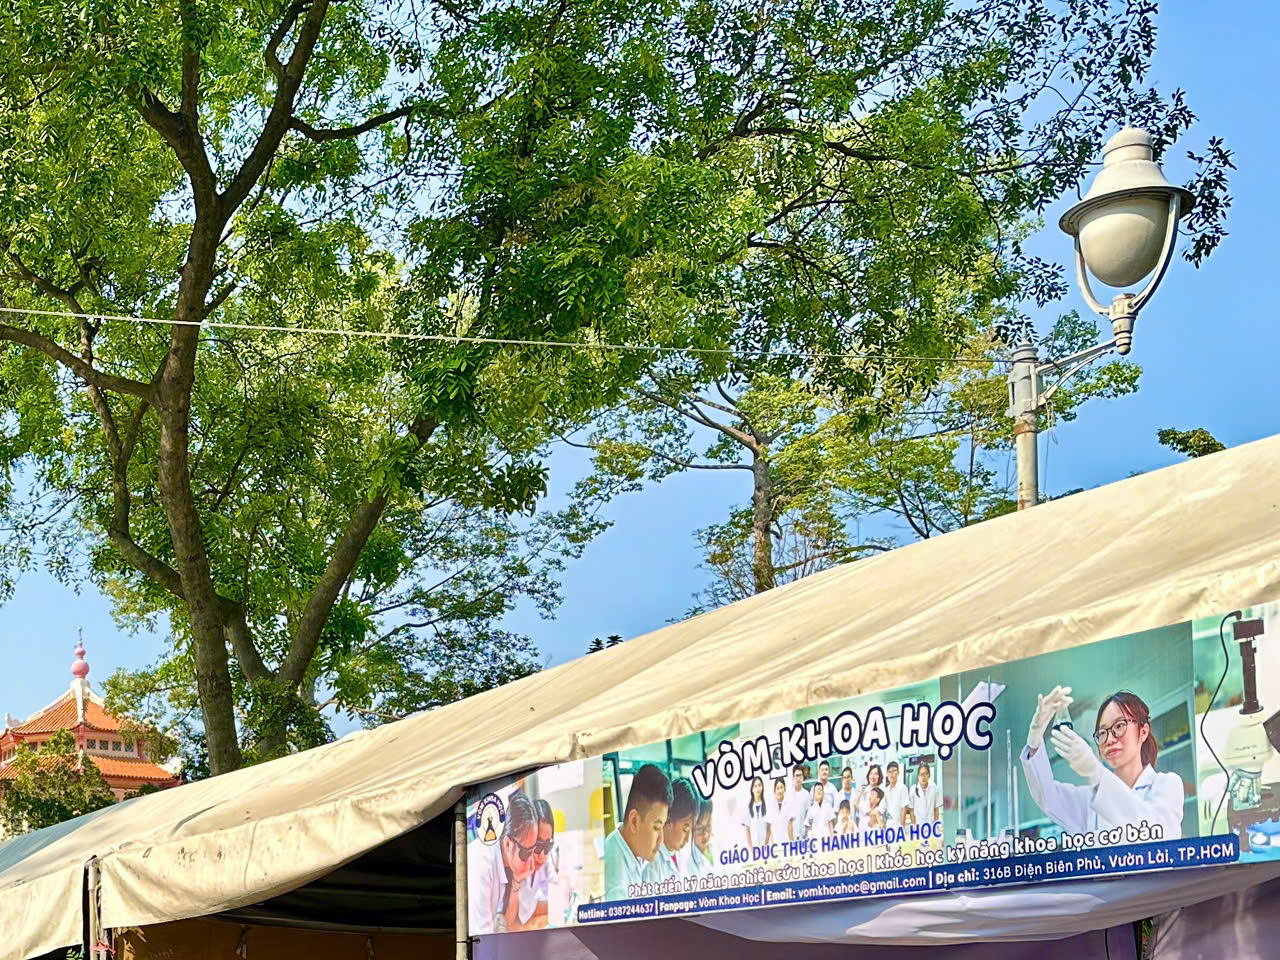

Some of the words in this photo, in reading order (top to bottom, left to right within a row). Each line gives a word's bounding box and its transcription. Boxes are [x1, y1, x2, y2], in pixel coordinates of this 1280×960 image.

[692, 740, 772, 800] VÒM
[780, 706, 891, 768] KHOA
[900, 701, 996, 760] HỌC
[578, 909, 608, 921] Hotline:
[608, 903, 654, 918] 0387244637
[659, 900, 697, 914] Fanpage:
[699, 896, 717, 908] Vòm
[719, 894, 741, 906] Khoa
[743, 892, 760, 905] Học
[766, 889, 796, 901] Email:
[798, 876, 926, 898] vomkhoahoc@gmail.com
[935, 873, 955, 888] Địa
[957, 868, 980, 883] chỉ:
[983, 866, 1012, 881] 316B
[1015, 864, 1043, 879] Điện
[1046, 860, 1073, 874] Biên
[1077, 855, 1105, 871] Phủ,
[1109, 852, 1144, 868] Vườn
[1148, 849, 1174, 865] Lài,
[1178, 842, 1234, 862] TP.HCM
[628, 881, 652, 898] Phát
[655, 875, 681, 894] triển
[683, 875, 698, 893] kỹ
[700, 873, 728, 890] năng
[730, 867, 773, 887] nghiên
[775, 863, 800, 881] cứu
[803, 862, 836, 878] khoa
[838, 858, 865, 876] học
[876, 846, 912, 870] Khóa
[916, 849, 943, 868] học
[946, 842, 965, 863] kỹ
[969, 839, 1010, 861] năng
[1014, 835, 1057, 854] khoa
[1061, 832, 1095, 852] học
[1098, 826, 1123, 846] cơ
[1126, 819, 1163, 842] bản
[720, 845, 749, 866] GIÁO
[753, 843, 778, 864] DỤC
[781, 838, 818, 860] THỰC
[821, 831, 860, 853] HÀNH
[864, 826, 906, 847] KHOA
[909, 821, 942, 845] HỌC
